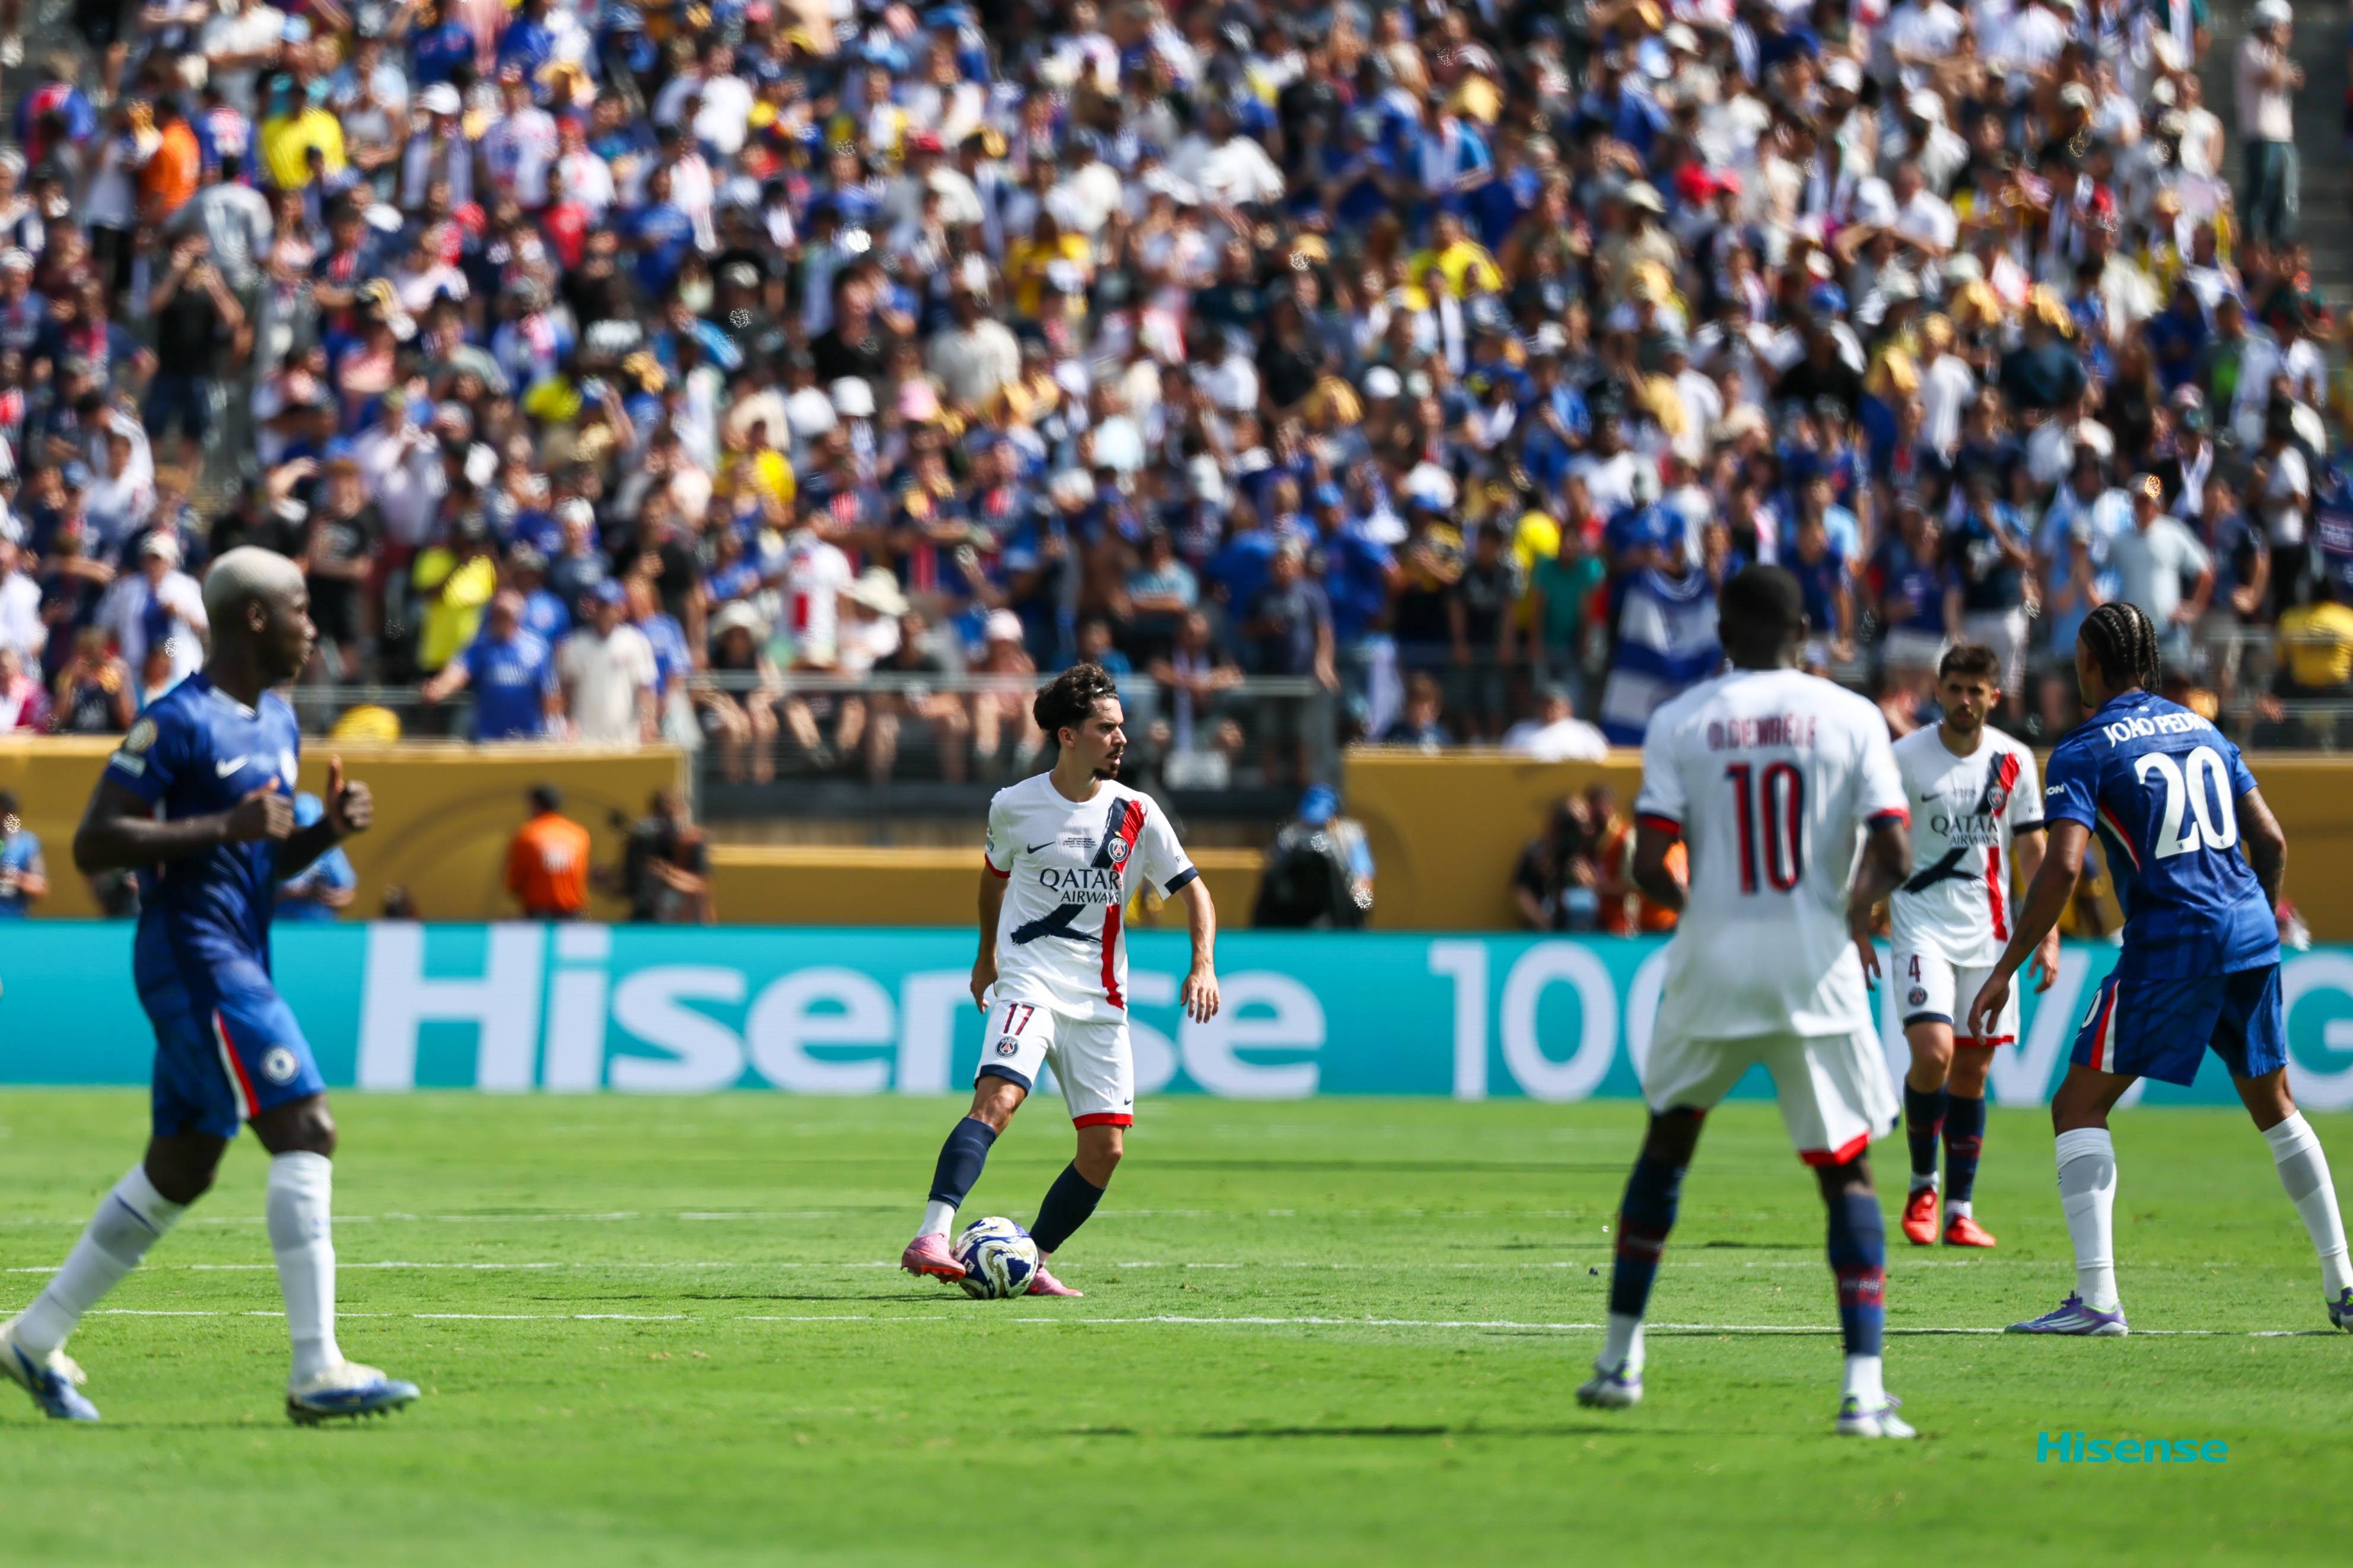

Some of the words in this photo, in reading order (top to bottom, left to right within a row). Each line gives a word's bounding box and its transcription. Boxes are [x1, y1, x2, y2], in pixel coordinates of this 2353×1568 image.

[2134, 746, 2237, 859] 20
[1725, 761, 1804, 895] 10
[1039, 868, 1120, 892] QATAR
[1061, 890, 1119, 904] AIRWAYS
[1908, 955, 1921, 982] 4
[1003, 1003, 1035, 1035] 17
